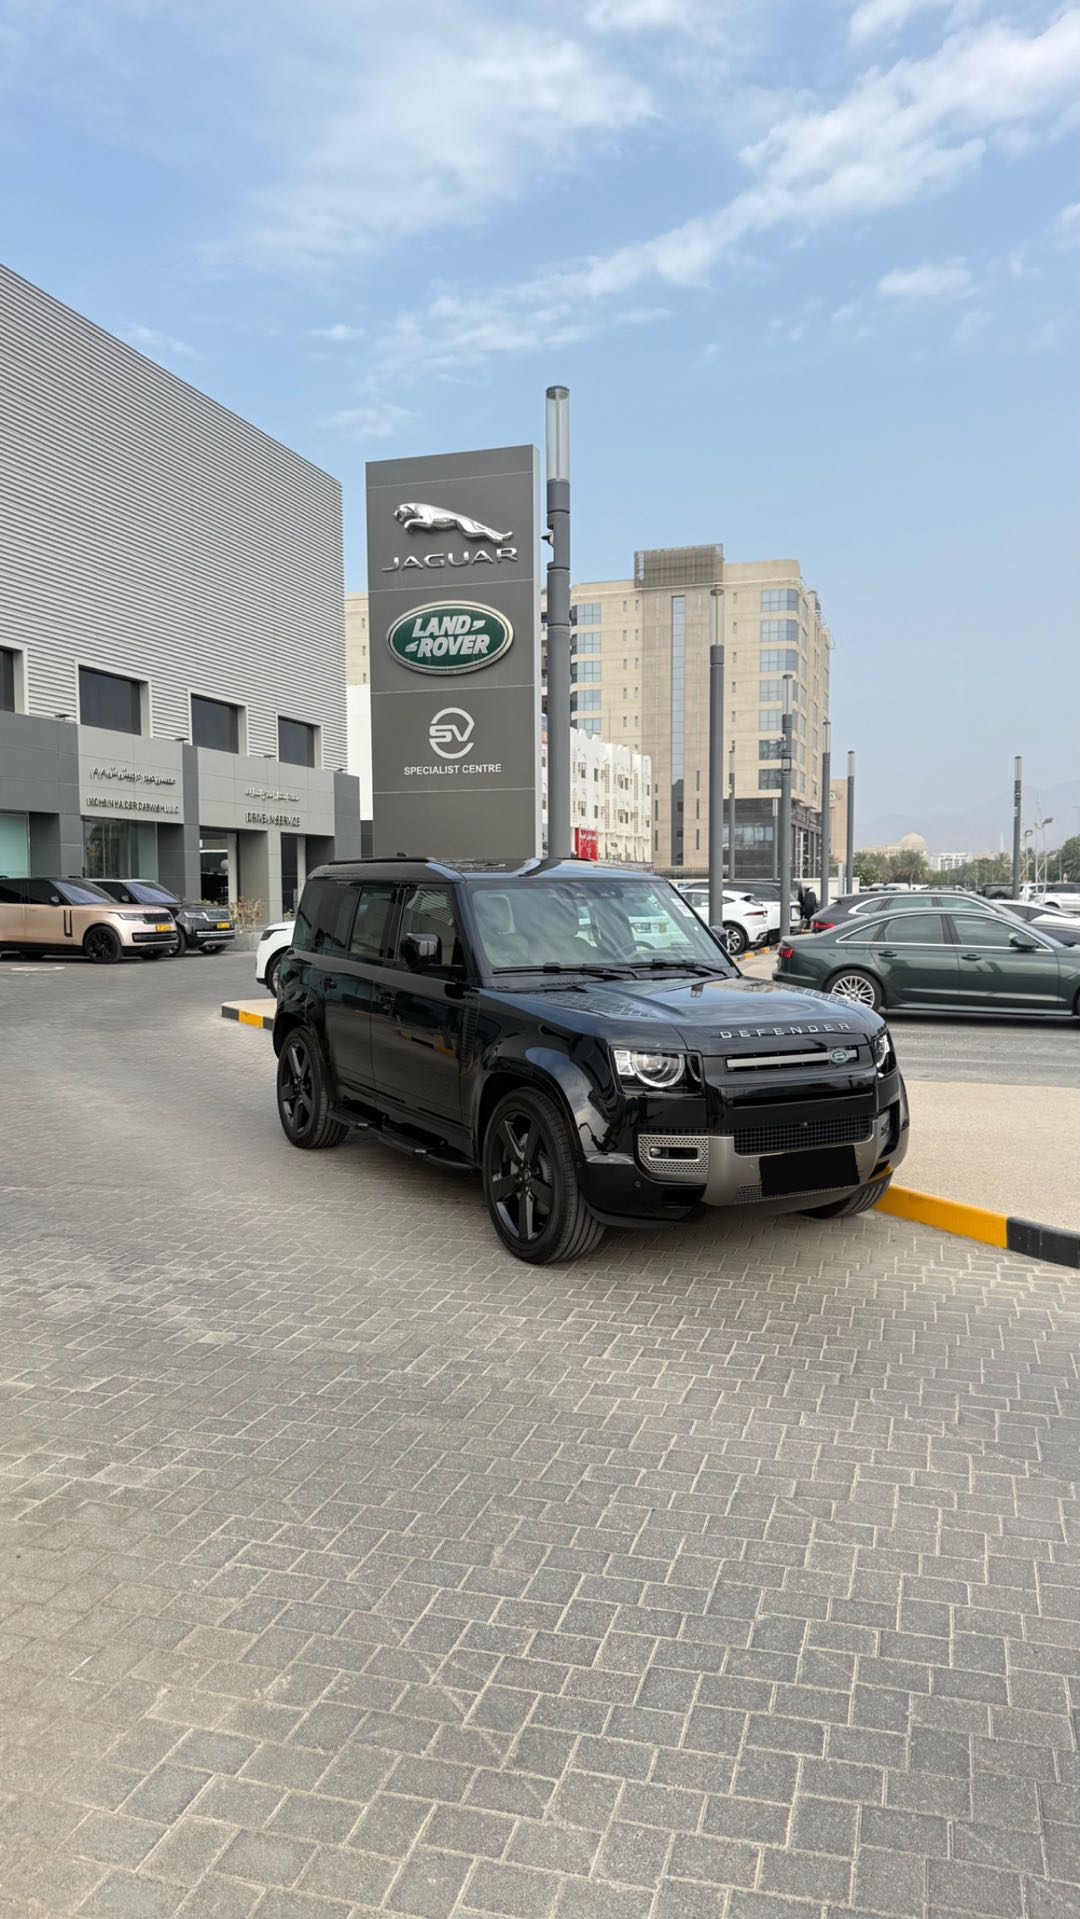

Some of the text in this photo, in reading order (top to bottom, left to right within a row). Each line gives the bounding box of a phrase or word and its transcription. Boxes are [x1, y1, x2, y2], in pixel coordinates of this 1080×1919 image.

[381, 547, 518, 572] JAGUAR
[412, 615, 471, 637] LAND
[417, 634, 490, 657] ROVER
[403, 763, 502, 775] SPECIALIST CENTRE
[719, 1022, 851, 1039] DEFENDER
